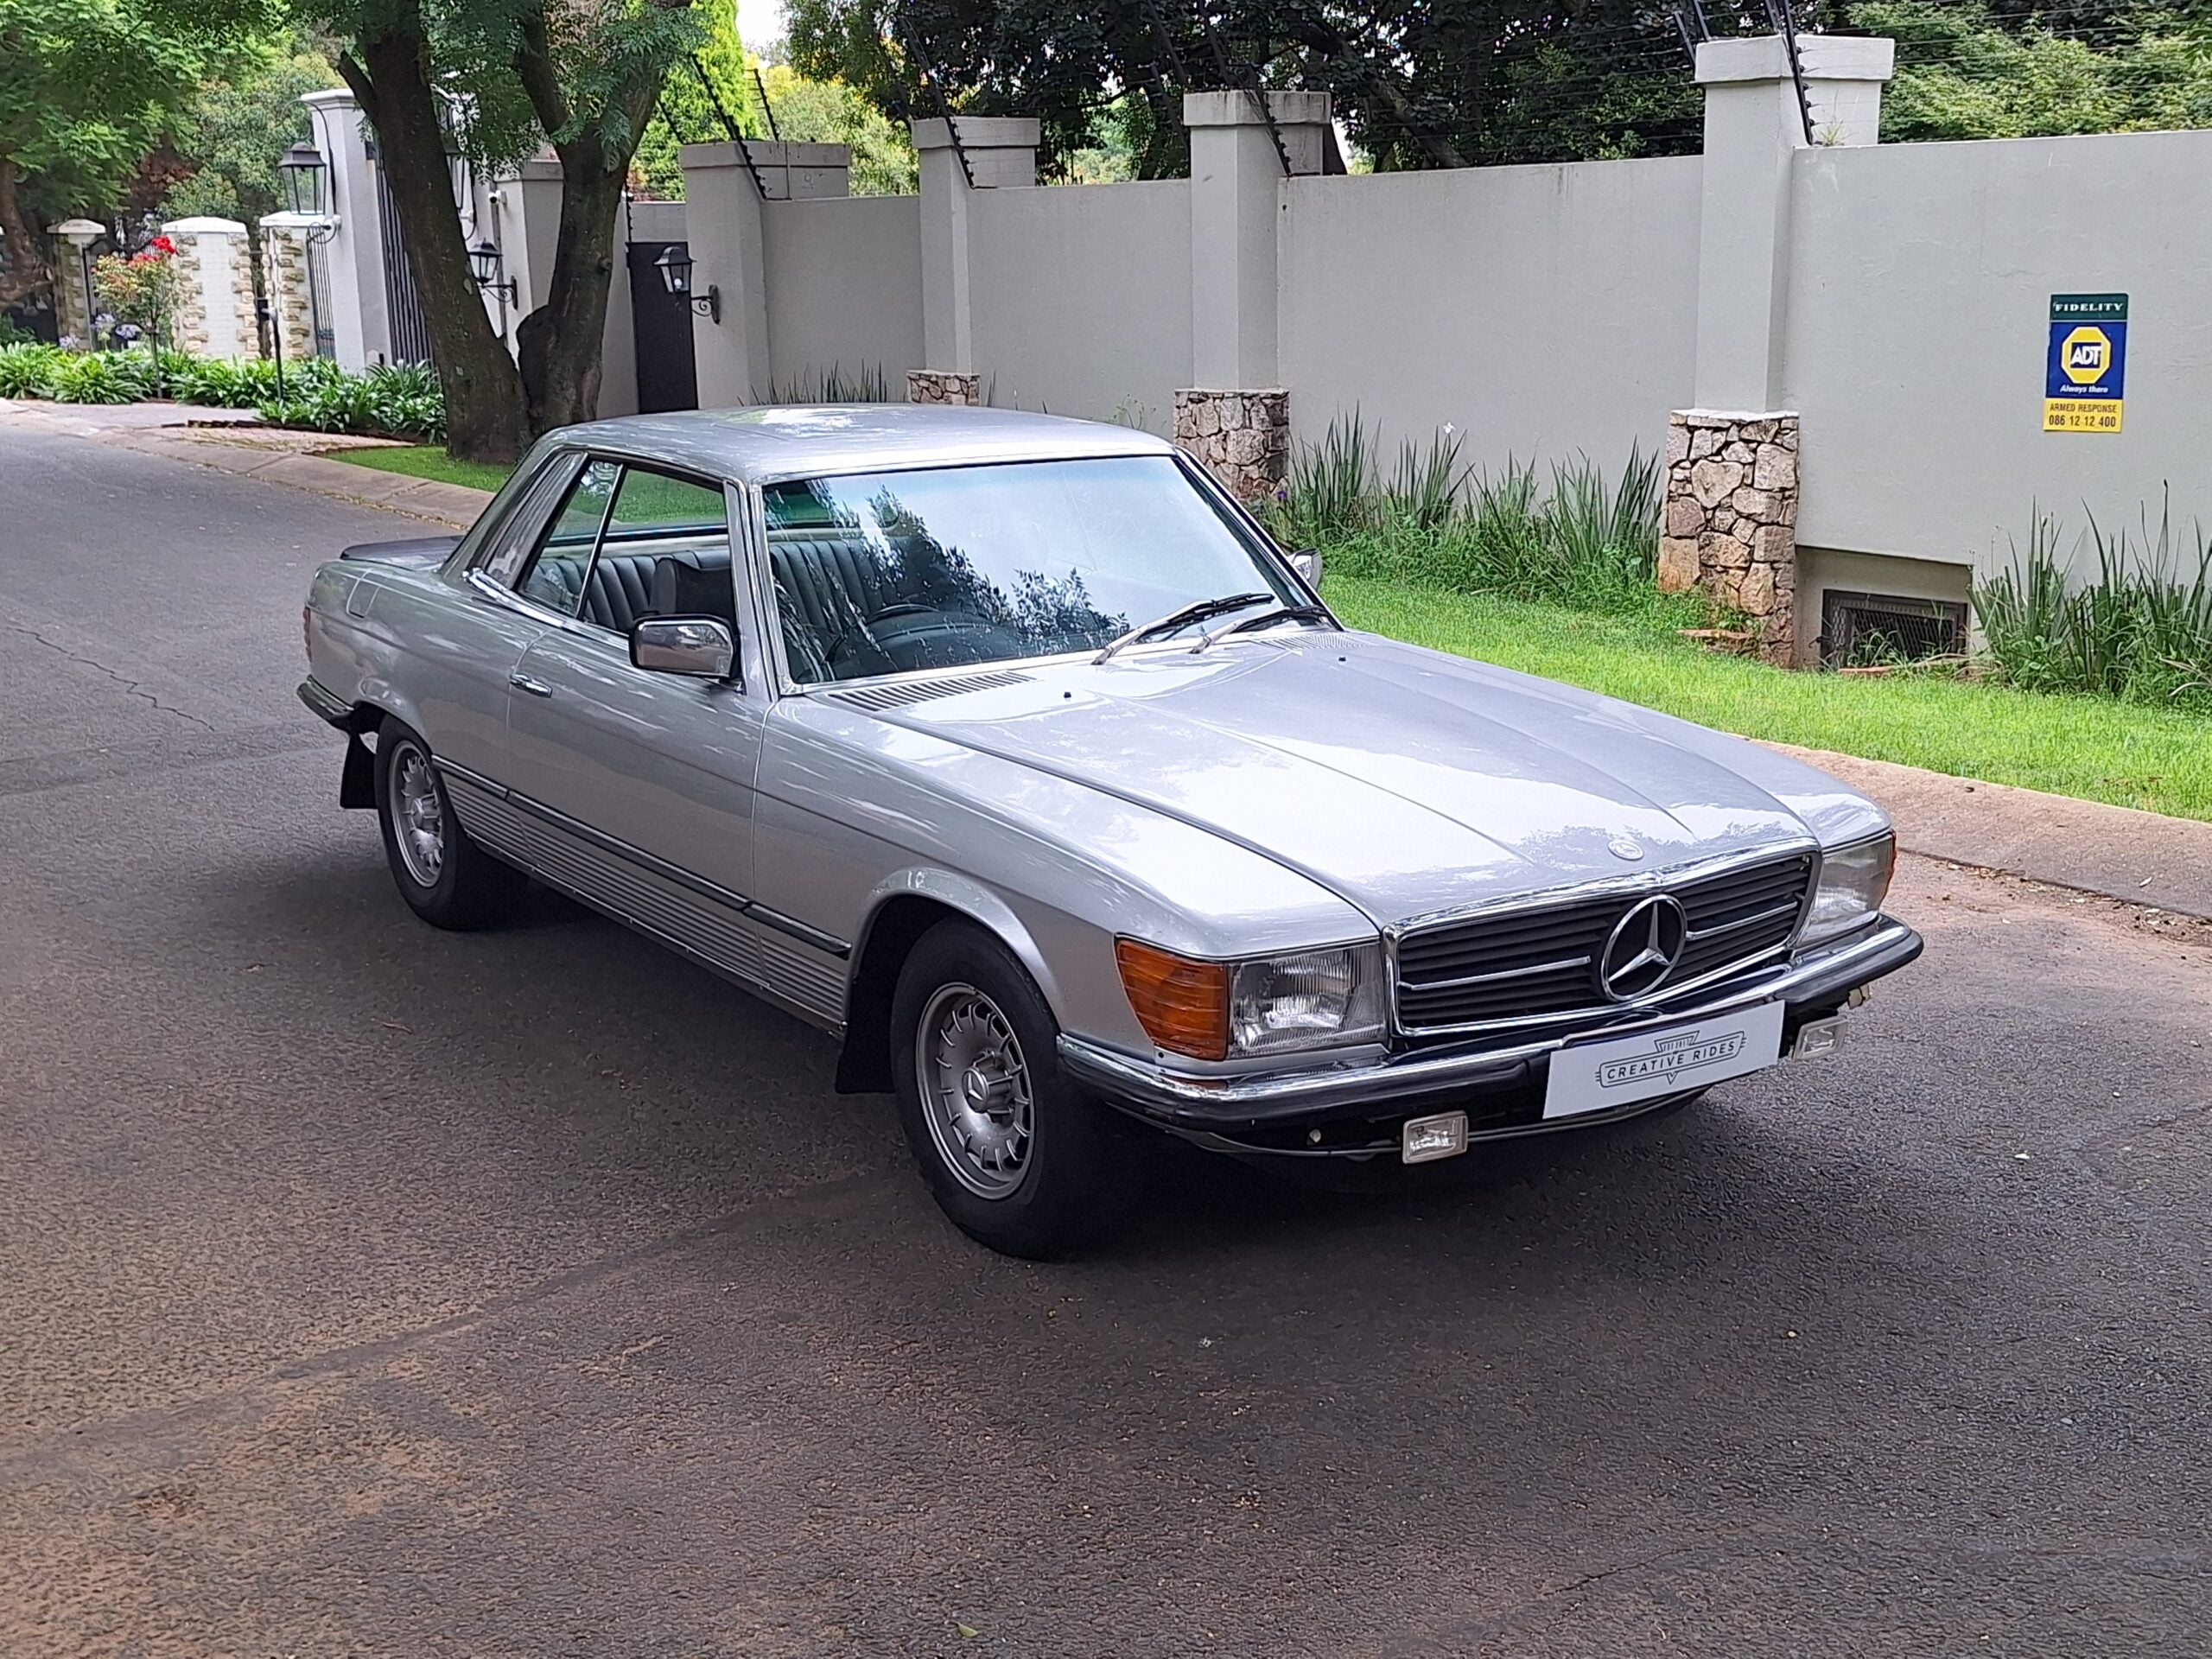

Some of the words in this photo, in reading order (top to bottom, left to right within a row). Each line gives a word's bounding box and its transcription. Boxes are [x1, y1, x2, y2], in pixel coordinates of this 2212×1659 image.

[2055, 302, 2124, 312] FIDELITY
[2070, 346, 2102, 365] ADT
[2060, 385, 2087, 394] Always
[2088, 385, 2108, 393] there
[2050, 404, 2075, 412] ARMED
[2078, 404, 2117, 413] RESPONSE
[2049, 415, 2065, 425] 086
[2070, 416, 2080, 426] 12
[2084, 416, 2094, 427] 12
[2098, 416, 2116, 427] 400
[1607, 1055, 1684, 1080] CREATIVE
[1692, 1041, 1735, 1061] RIDES
